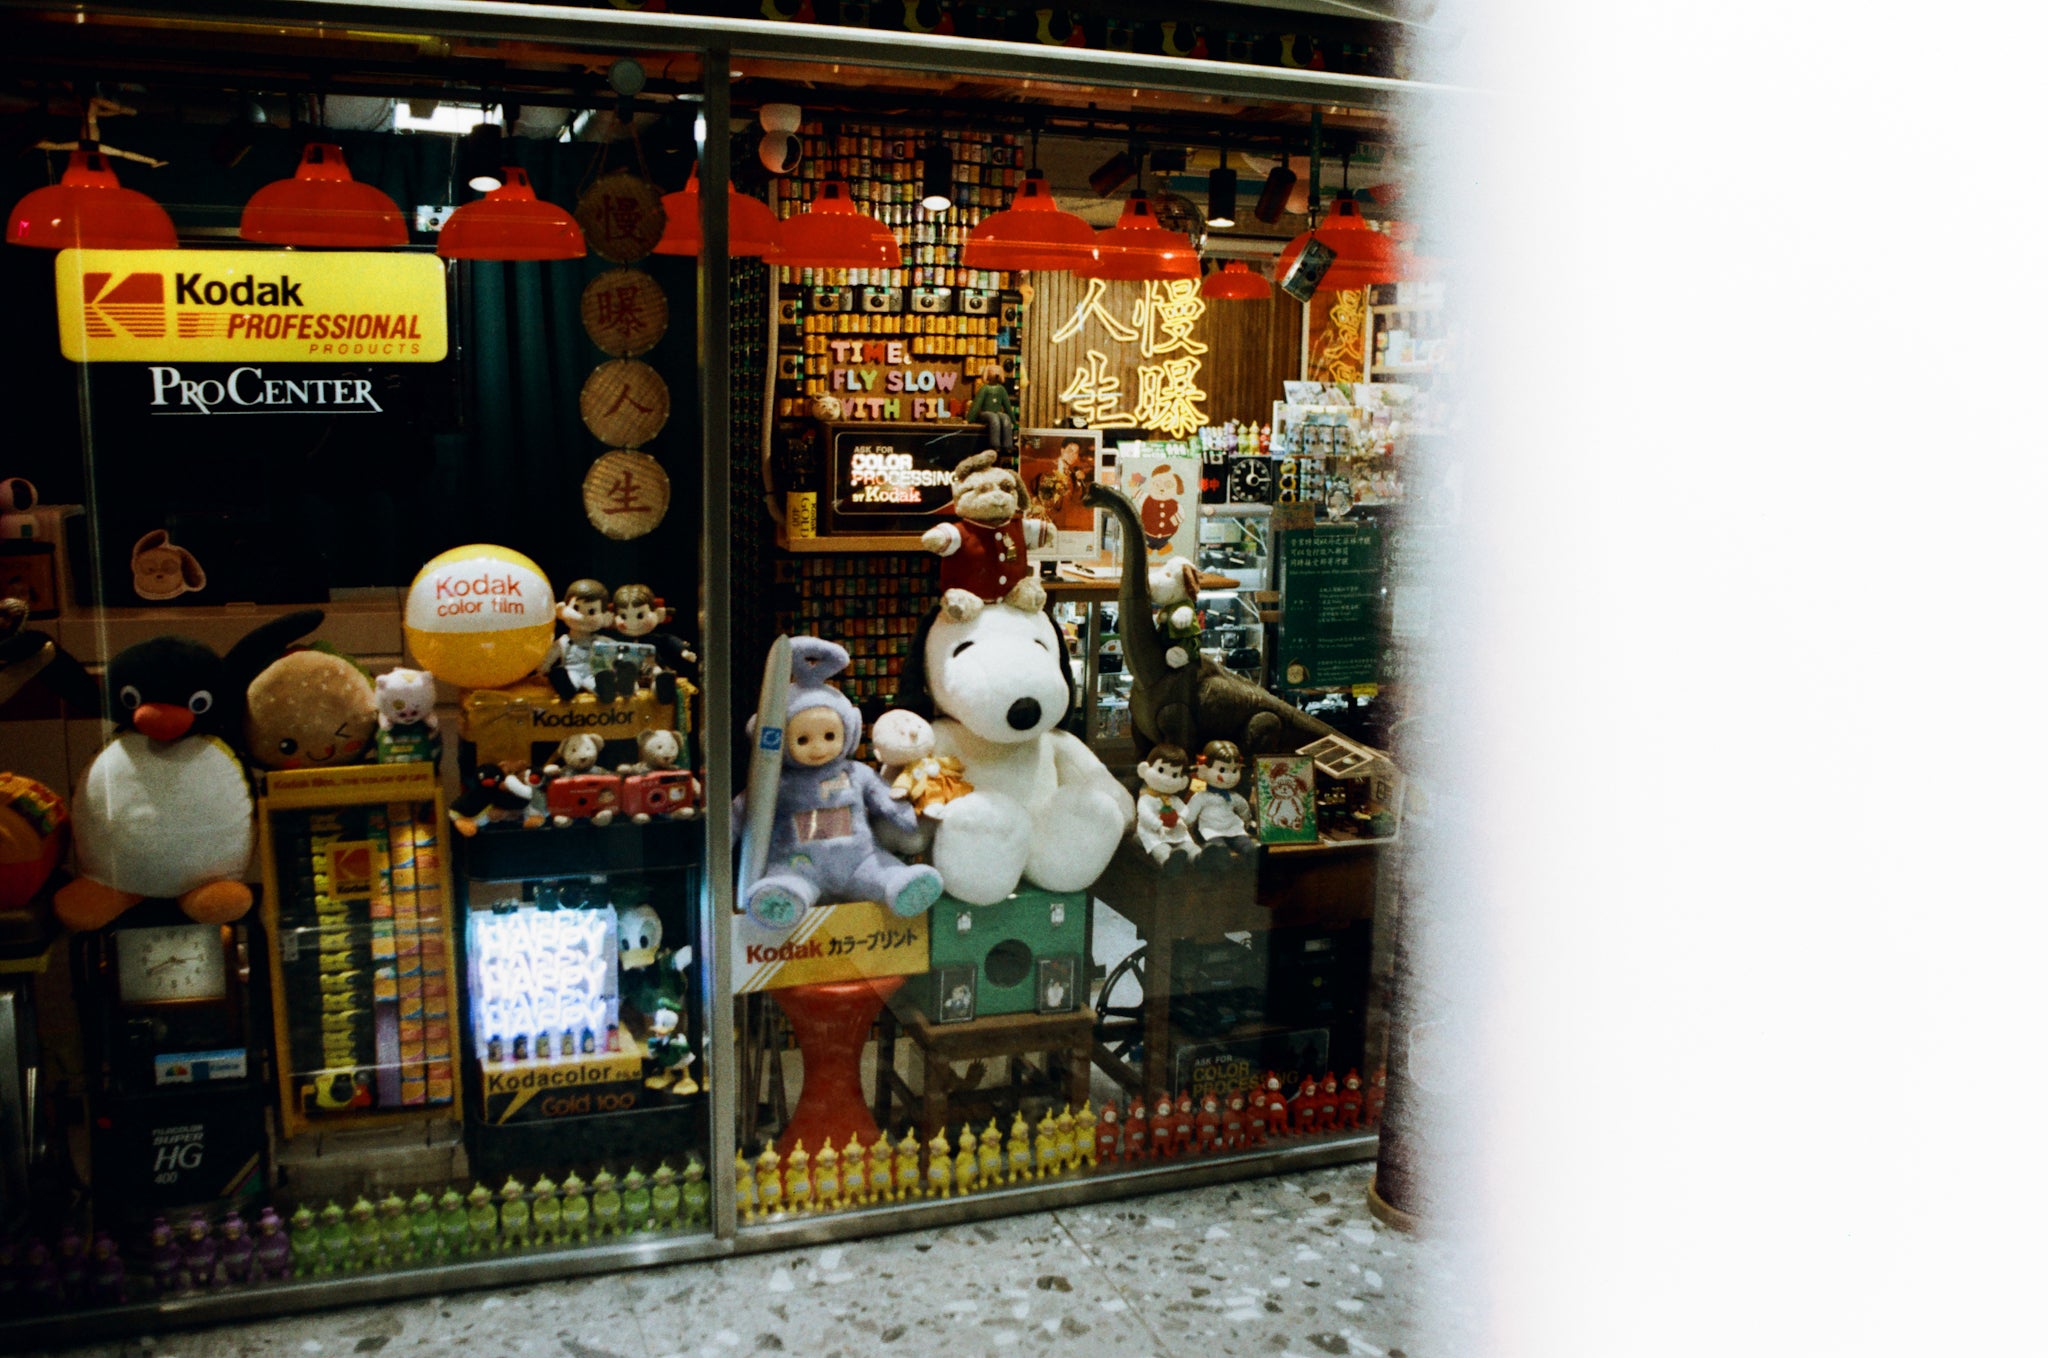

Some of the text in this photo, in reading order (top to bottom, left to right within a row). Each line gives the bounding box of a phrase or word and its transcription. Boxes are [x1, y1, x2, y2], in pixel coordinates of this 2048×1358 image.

[176, 273, 304, 306] Kodak
[227, 314, 422, 339] PROFESSIONAL
[308, 343, 421, 355] PRODUCTS
[1051, 277, 1140, 430] 人生
[833, 369, 957, 392] FLY SLOW
[875, 446, 894, 454] FOR
[851, 454, 913, 470] COLOR
[865, 486, 922, 503] Kodak
[800, 498, 809, 537] GOLD
[436, 574, 522, 600] Kodak
[437, 599, 525, 617] color film
[533, 709, 634, 728] Kodacolor
[746, 928, 917, 964] Kodak カラープリント
[1214, 1055, 1232, 1064] FOR
[488, 1067, 611, 1091] Kodacolor
[1192, 1061, 1250, 1083] COLOR
[541, 1092, 634, 1115] Gold 100
[152, 1133, 204, 1146] SUPER
[153, 1143, 205, 1173] HG
[153, 1170, 178, 1184] 400
